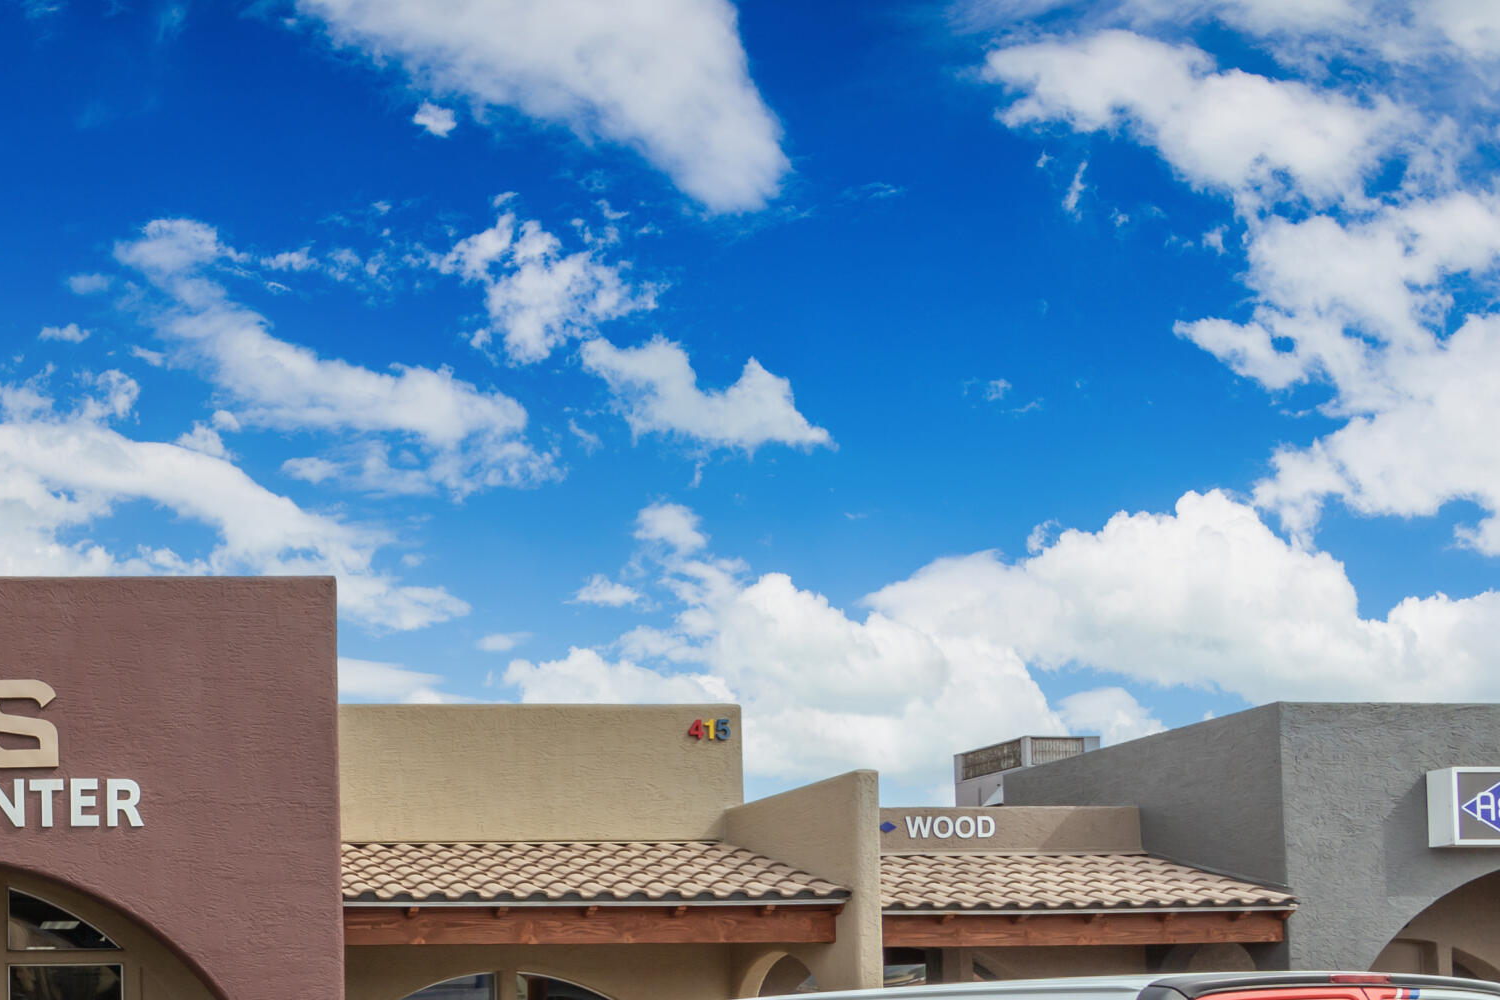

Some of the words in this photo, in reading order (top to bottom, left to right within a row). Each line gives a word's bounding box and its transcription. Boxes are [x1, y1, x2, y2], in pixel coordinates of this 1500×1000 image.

[688, 718, 731, 741] 415
[1476, 791, 1500, 821] A
[904, 815, 996, 839] WOOD
